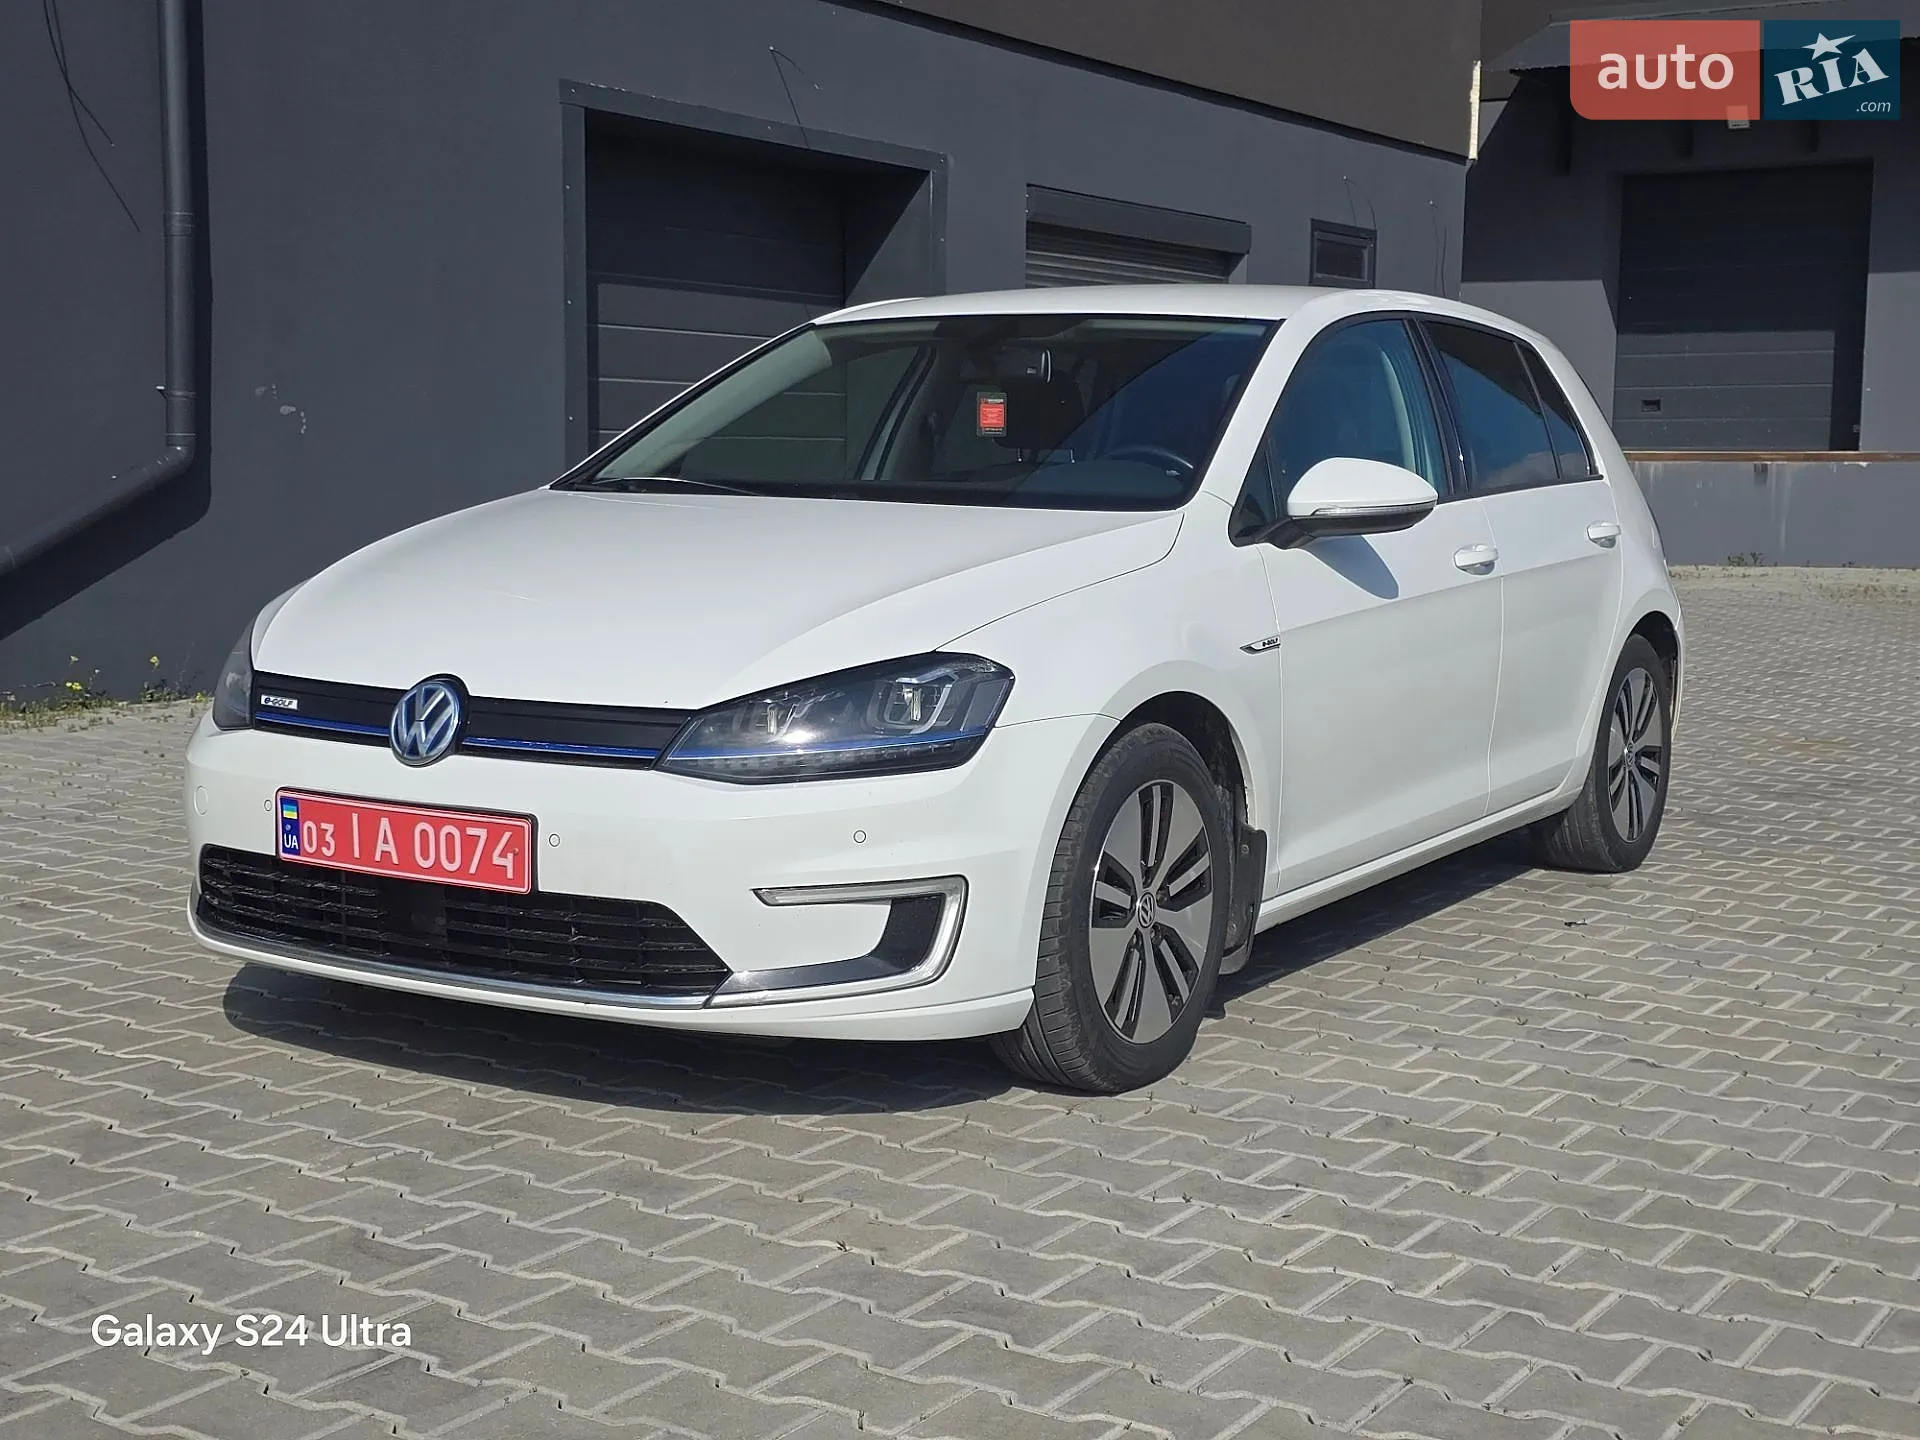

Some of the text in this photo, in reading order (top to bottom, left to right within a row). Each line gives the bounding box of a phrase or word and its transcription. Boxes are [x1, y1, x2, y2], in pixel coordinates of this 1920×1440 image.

[283, 833, 299, 850] UA
[303, 820, 336, 857] 03
[414, 822, 517, 879] 0074
